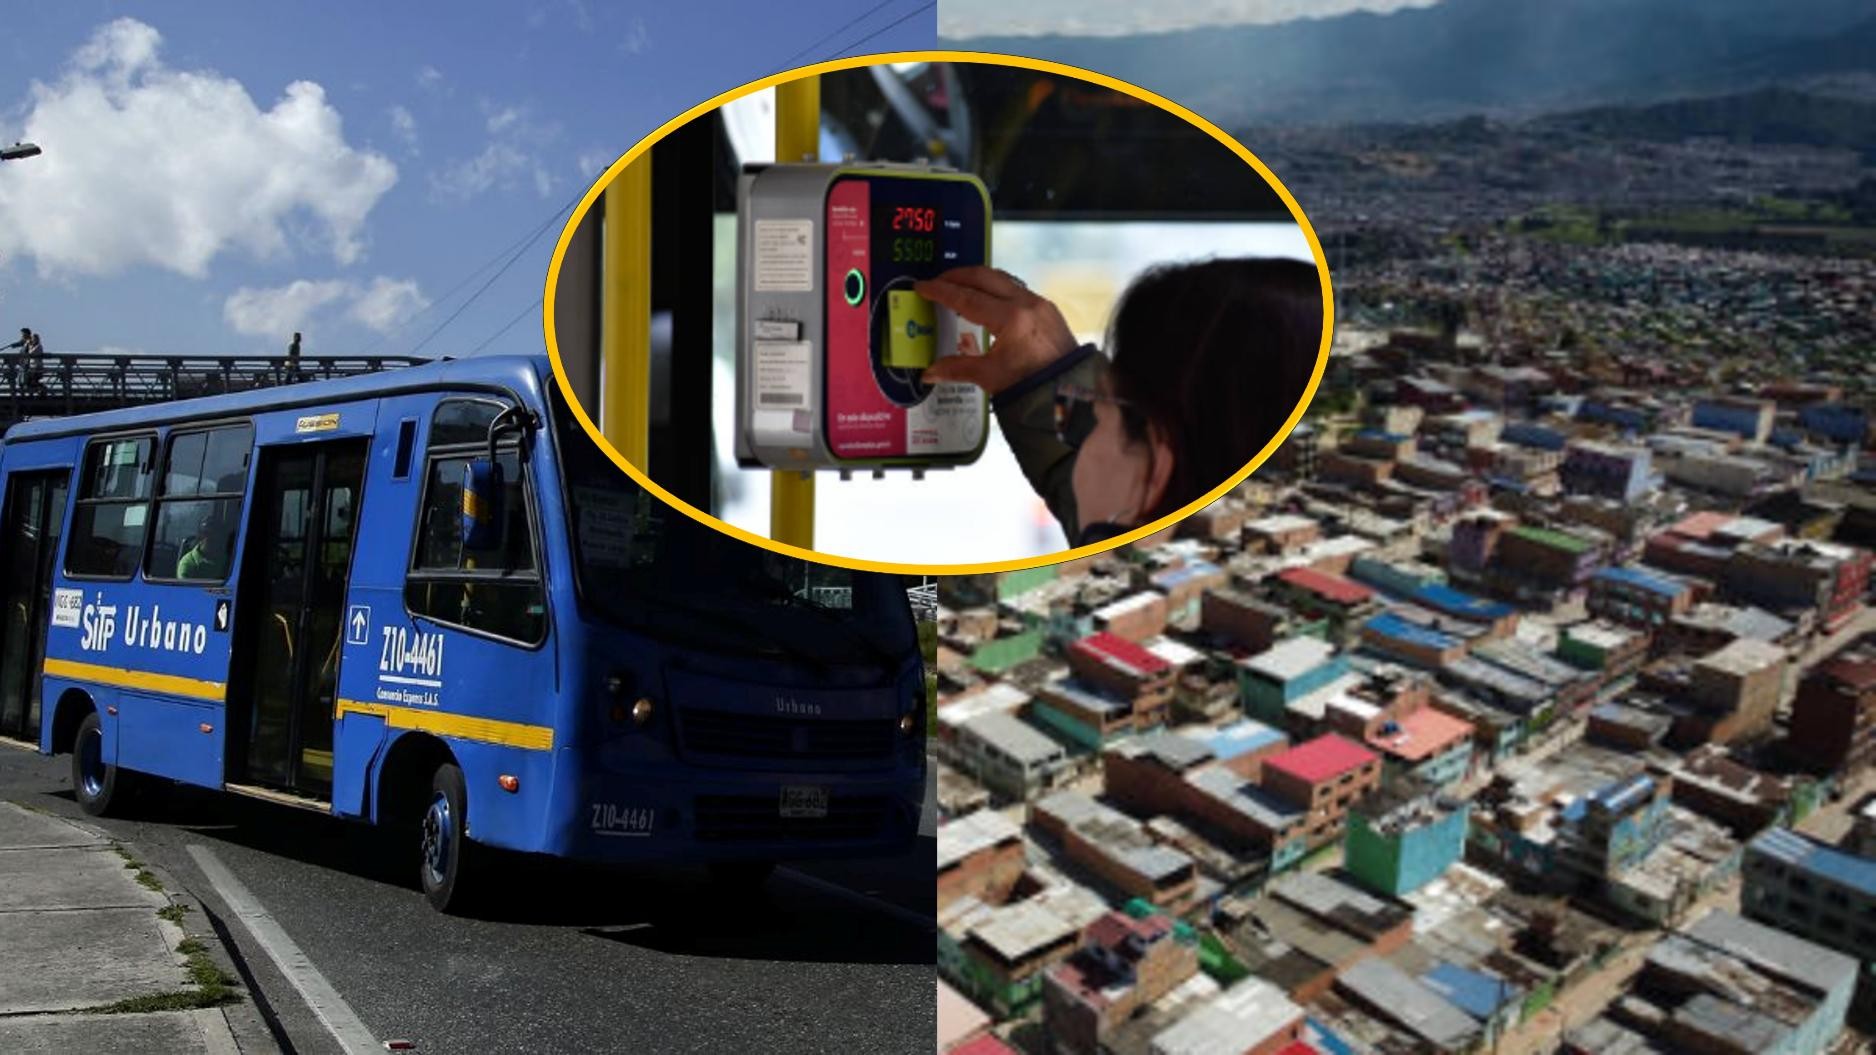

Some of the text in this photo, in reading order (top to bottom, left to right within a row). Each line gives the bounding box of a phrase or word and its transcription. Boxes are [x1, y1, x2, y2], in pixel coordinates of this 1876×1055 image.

[892, 207, 935, 232] 2750
[124, 604, 207, 654] Urbano
[379, 626, 444, 676] Z10-4461
[776, 698, 822, 715] Urbano
[592, 803, 655, 831] Z10-4461
